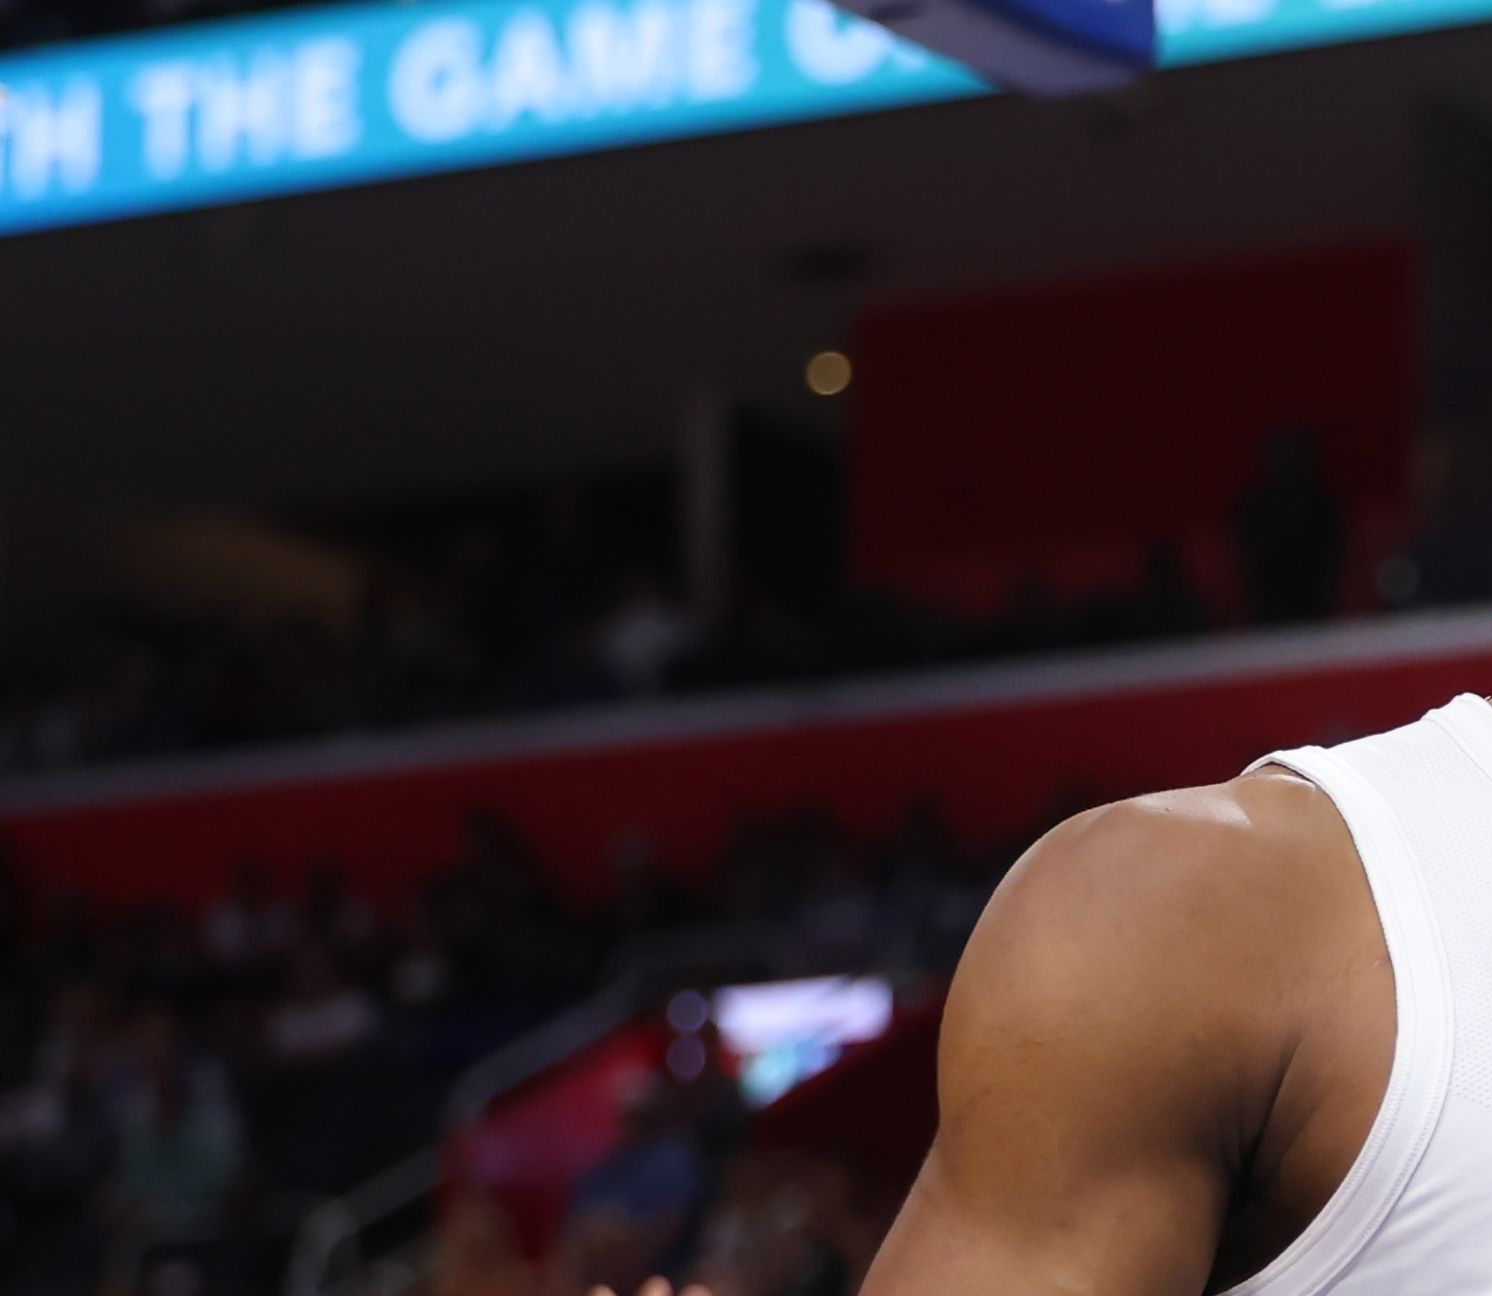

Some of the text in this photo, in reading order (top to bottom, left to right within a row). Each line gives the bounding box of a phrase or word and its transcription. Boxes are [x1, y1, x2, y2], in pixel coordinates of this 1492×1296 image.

[0, 74, 101, 196] H
[130, 37, 362, 180] THE
[390, 0, 757, 142] GAME
